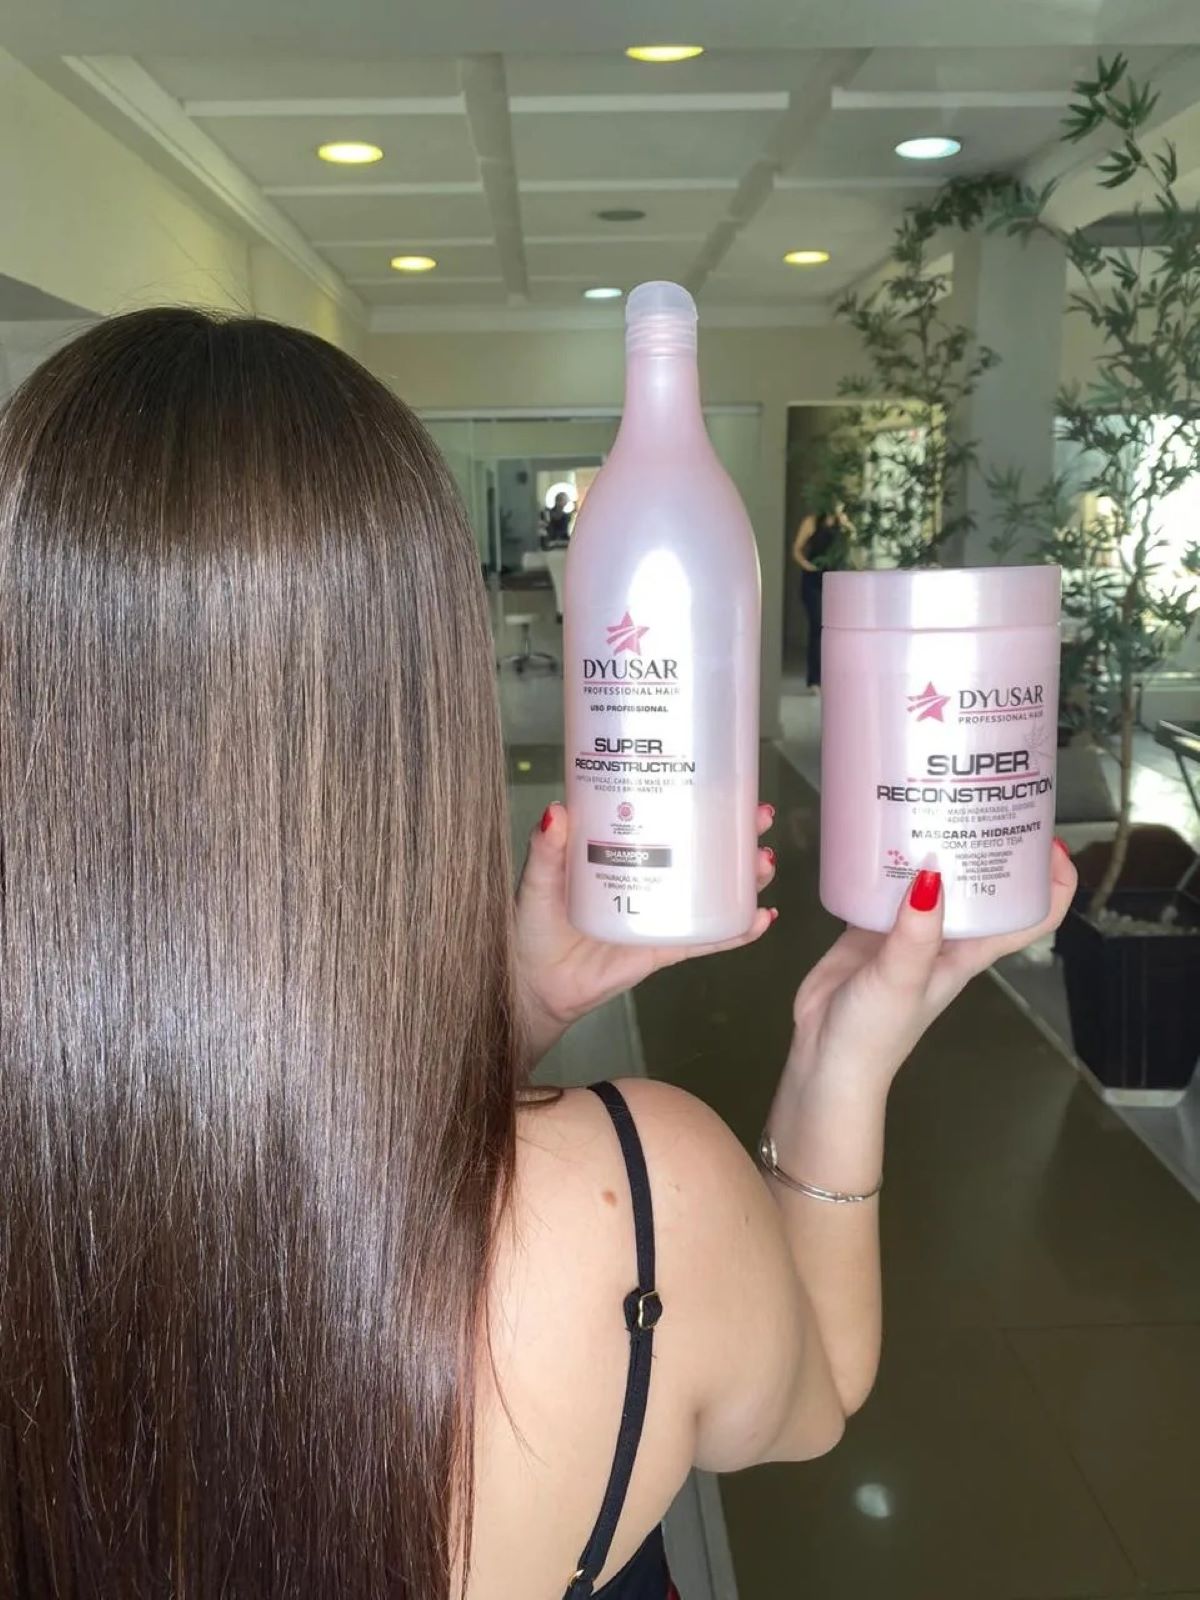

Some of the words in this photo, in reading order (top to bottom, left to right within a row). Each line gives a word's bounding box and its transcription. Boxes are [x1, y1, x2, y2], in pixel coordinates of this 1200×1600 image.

[583, 659, 678, 679] DYUSAR
[583, 686, 652, 695] PROFESSIONAL
[655, 687, 680, 695] HAIR
[959, 684, 1043, 709] DYUSAR
[958, 714, 1027, 724] PROFESSIONAL
[594, 737, 663, 754] SUPER
[575, 758, 695, 773] RECONSTRUCTION
[927, 750, 1029, 775] SUPER
[877, 775, 1053, 803] RECONSTRUCTION
[981, 821, 1041, 838] HIDRATANTE
[970, 838, 1004, 848] EFEITO
